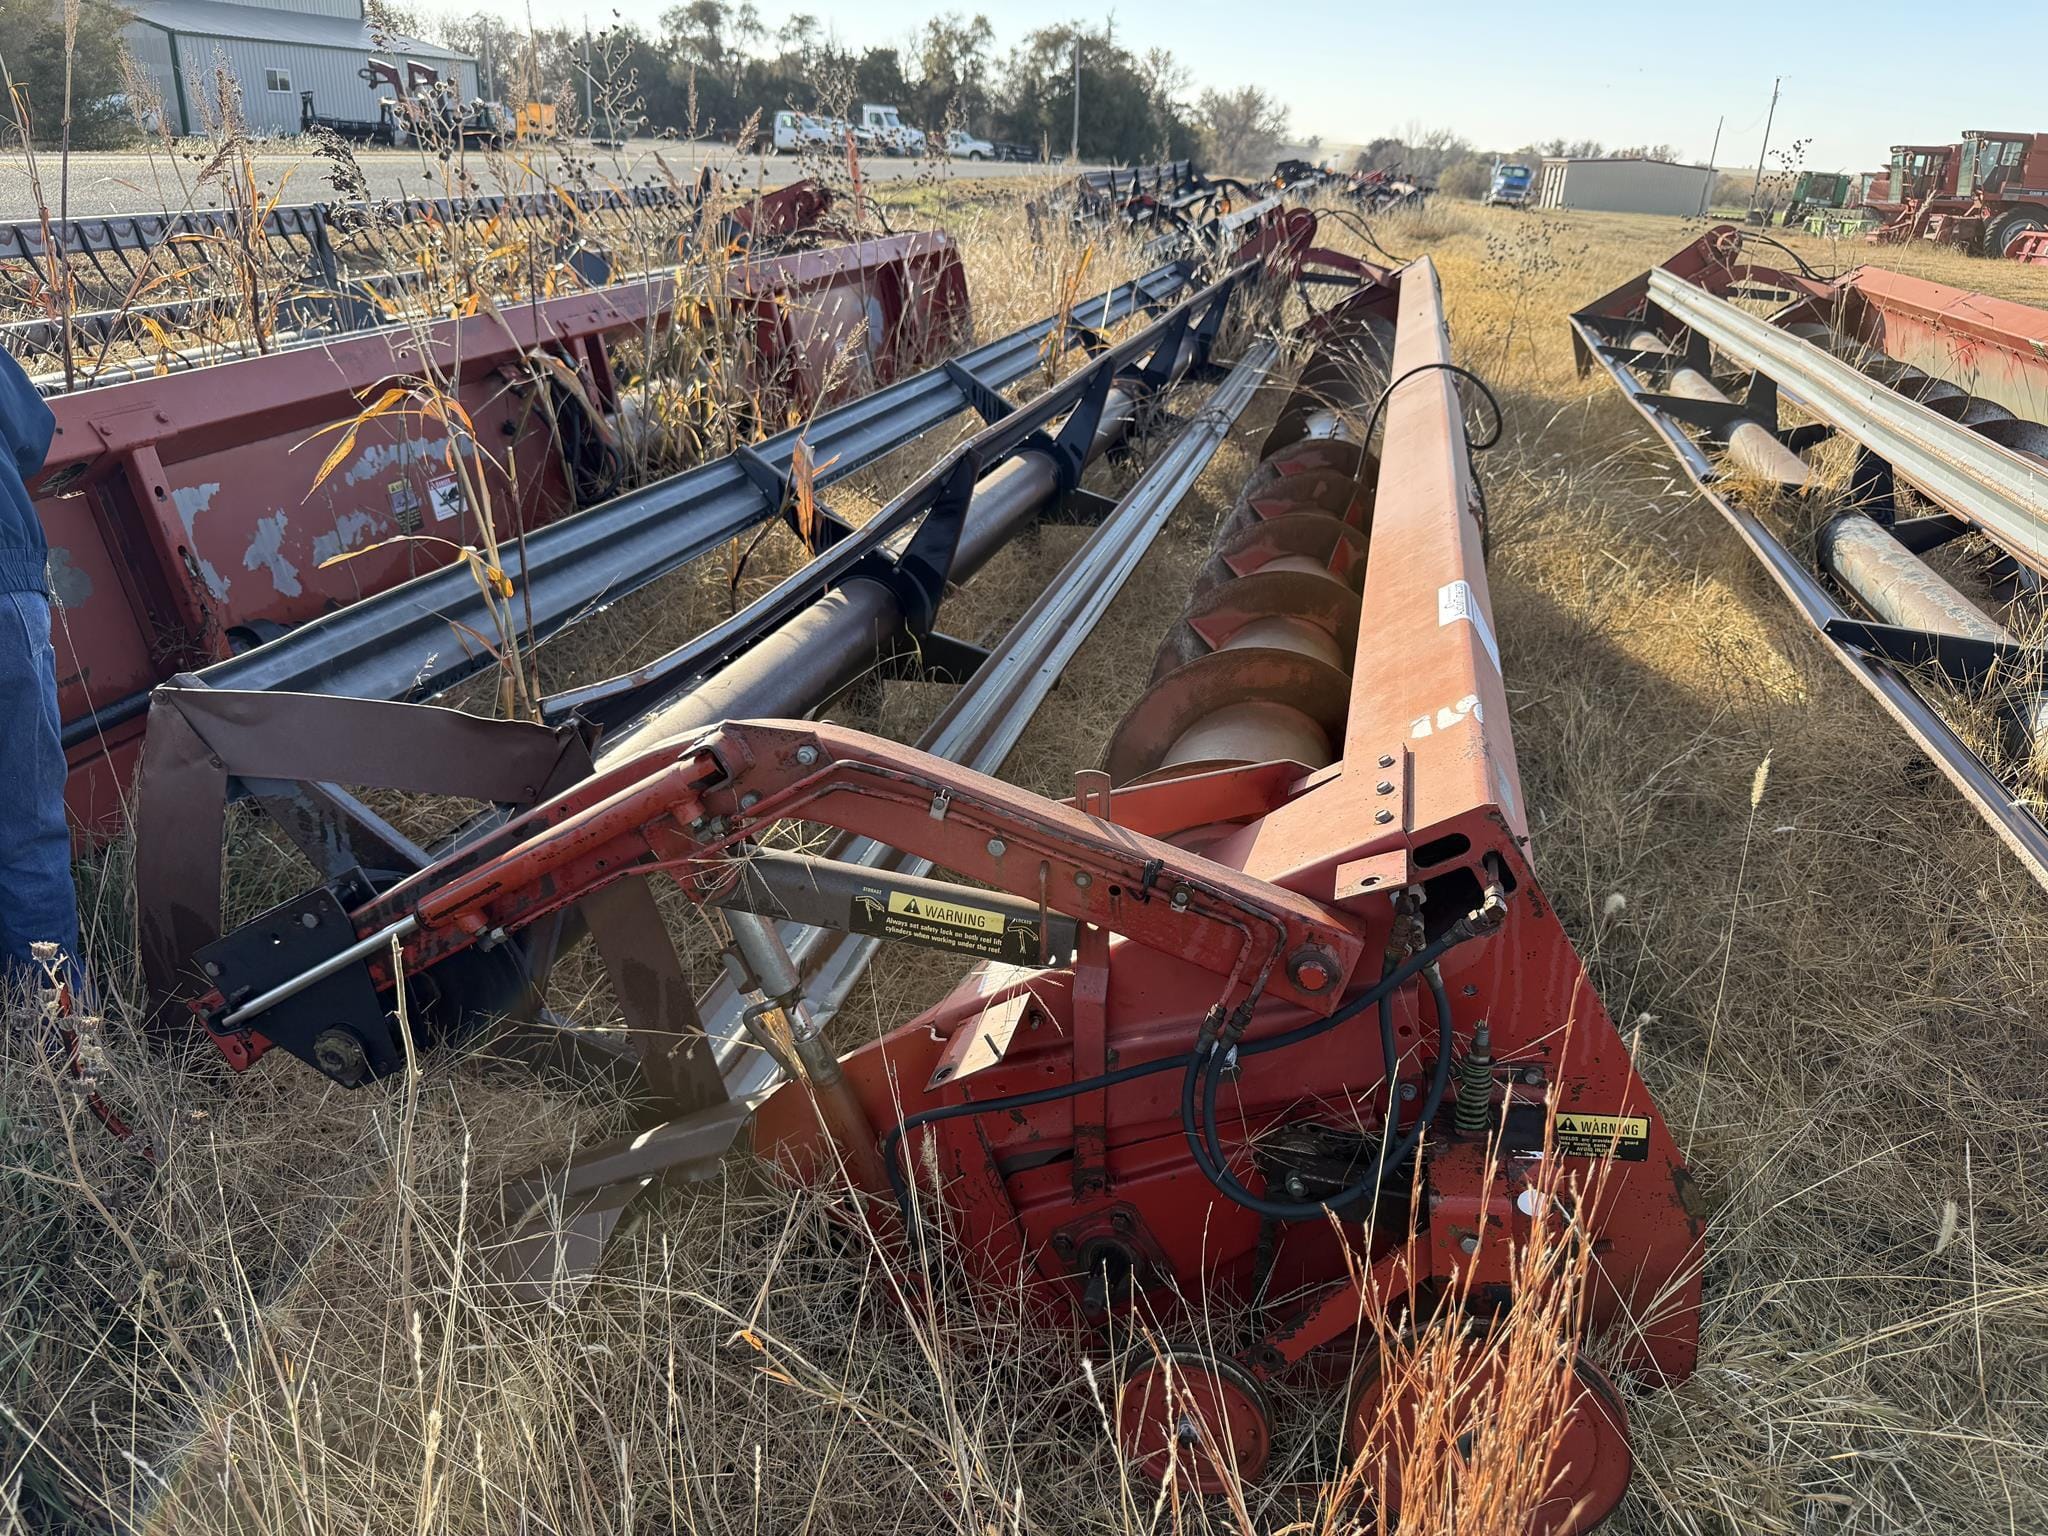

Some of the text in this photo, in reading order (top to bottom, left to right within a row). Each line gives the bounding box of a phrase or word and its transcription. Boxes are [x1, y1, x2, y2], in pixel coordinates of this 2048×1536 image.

[925, 904, 986, 928] WARNING
[885, 926, 912, 936] cylinders
[913, 931, 930, 940] when
[931, 935, 956, 946] working
[957, 940, 976, 949] under
[976, 943, 987, 952] the
[886, 916, 908, 927] Always
[920, 925, 939, 934] safety
[940, 928, 953, 936] lock
[964, 932, 979, 941] both
[980, 936, 992, 944] reel
[993, 937, 1003, 946] lift
